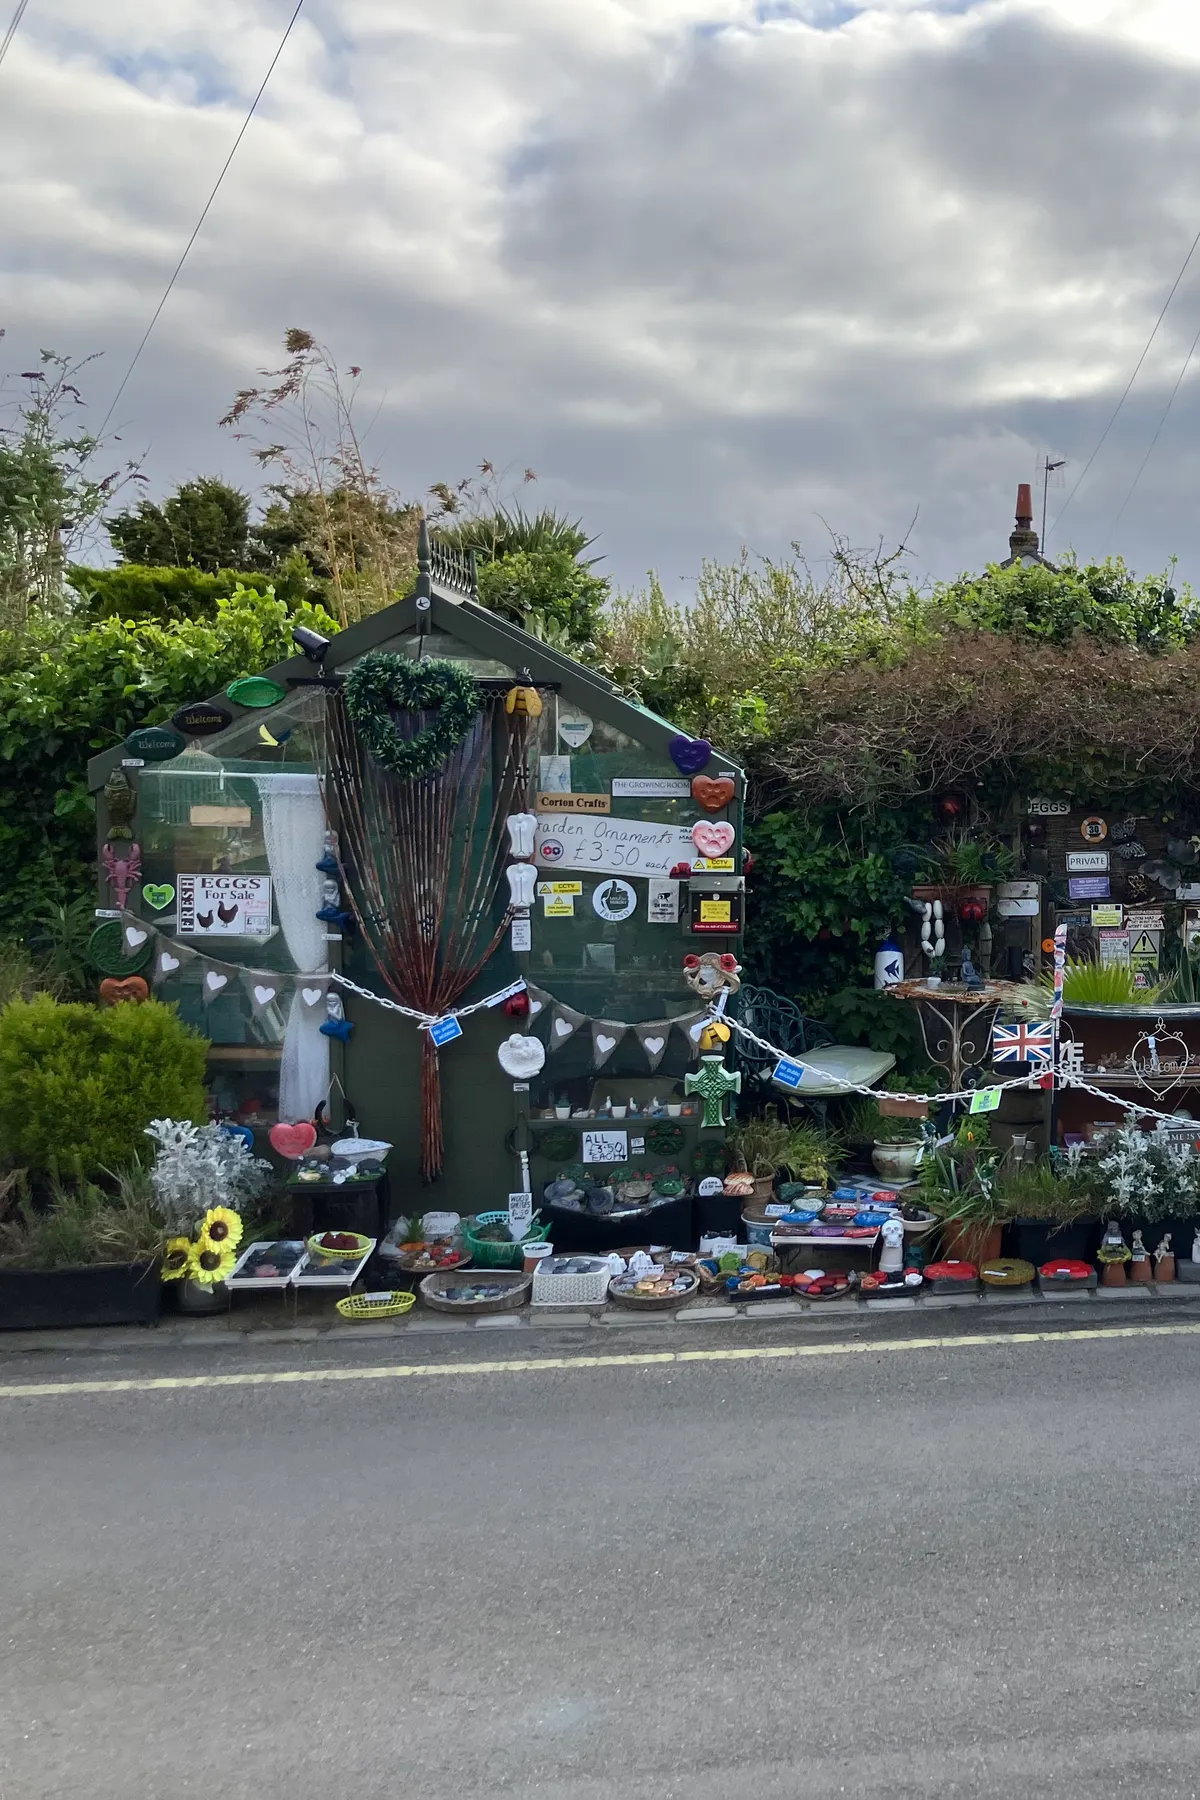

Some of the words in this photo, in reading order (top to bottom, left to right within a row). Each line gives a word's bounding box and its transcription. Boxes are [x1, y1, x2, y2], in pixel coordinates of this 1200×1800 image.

[184, 712, 223, 725] Welcome
[138, 737, 177, 749] Welcome
[614, 781, 626, 789] THE
[628, 781, 666, 789] GROWING
[667, 781, 690, 789] ROOM
[576, 797, 606, 809] Crafts
[1031, 802, 1067, 813] EGGS
[594, 821, 674, 846] Ornaments
[1088, 825, 1099, 834] 30
[645, 856, 669, 871] each
[1070, 857, 1106, 866] PRIVATE
[200, 877, 261, 890] EGGS
[205, 890, 227, 900] For
[229, 890, 255, 900] Sale
[181, 878, 194, 930] FRESH
[599, 908, 630, 920] FRIEND
[585, 1133, 609, 1144] ALL
[591, 1152, 622, 1161] EACH
